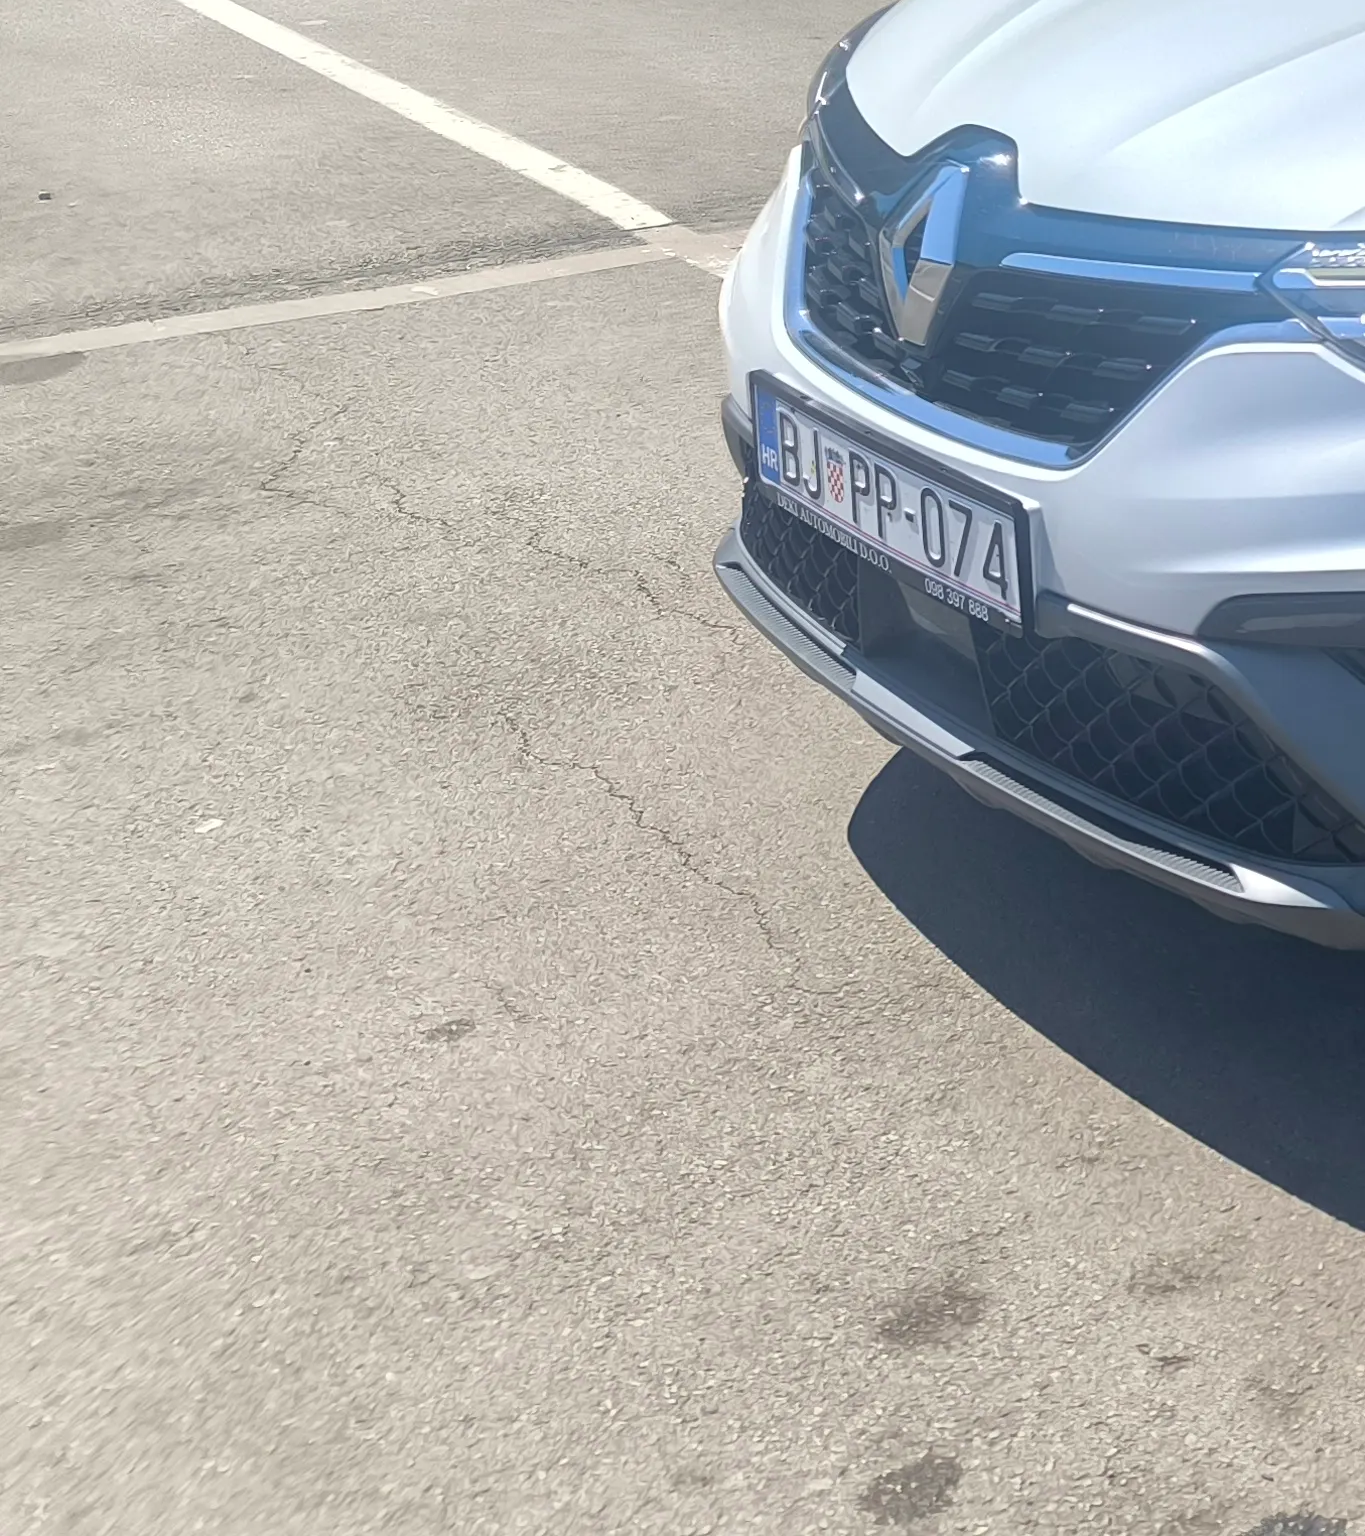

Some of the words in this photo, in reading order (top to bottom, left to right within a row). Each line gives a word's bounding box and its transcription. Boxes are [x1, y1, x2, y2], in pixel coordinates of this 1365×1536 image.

[761, 443, 779, 473] HR
[777, 492, 799, 517] DEKI
[800, 509, 858, 555] AUTOMOBILI
[780, 410, 822, 500] BJ
[849, 454, 1009, 600] PP-074
[924, 577, 944, 599] 098
[946, 588, 966, 611] 397
[968, 597, 989, 622] 888
